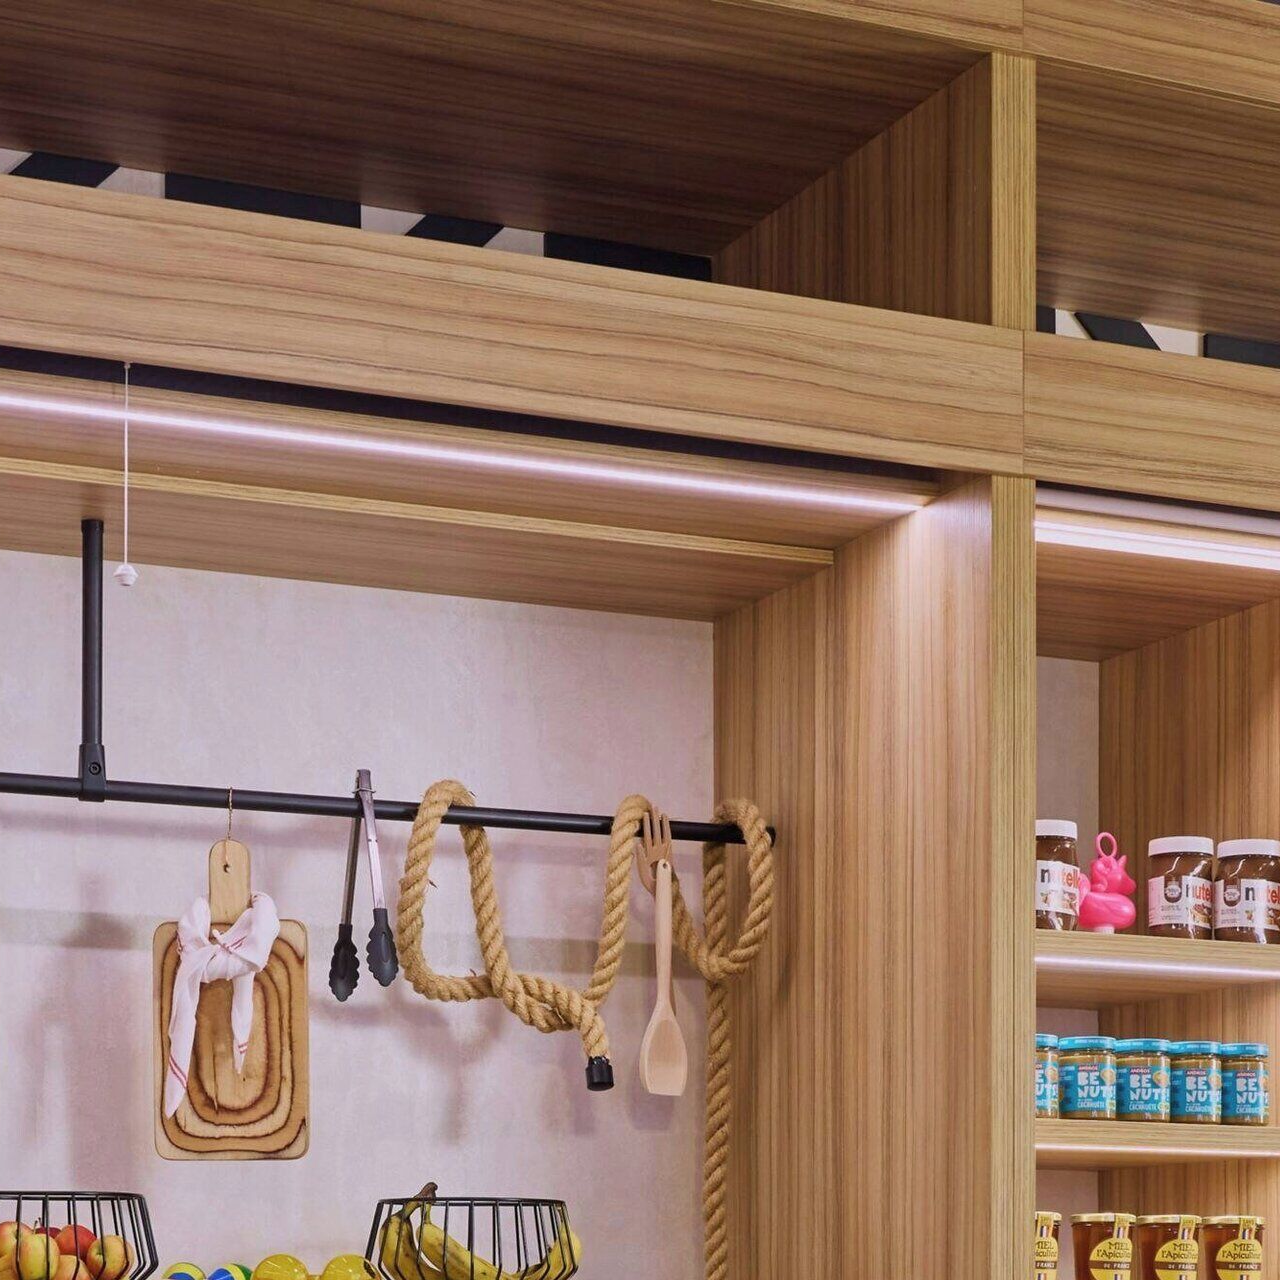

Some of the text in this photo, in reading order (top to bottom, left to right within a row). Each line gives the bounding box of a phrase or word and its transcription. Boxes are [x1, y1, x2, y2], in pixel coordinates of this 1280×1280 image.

[1078, 1071, 1099, 1086] BE
[1130, 1074, 1151, 1088] BE
[1186, 1076, 1207, 1090] BE
[1236, 1078, 1257, 1092] BE
